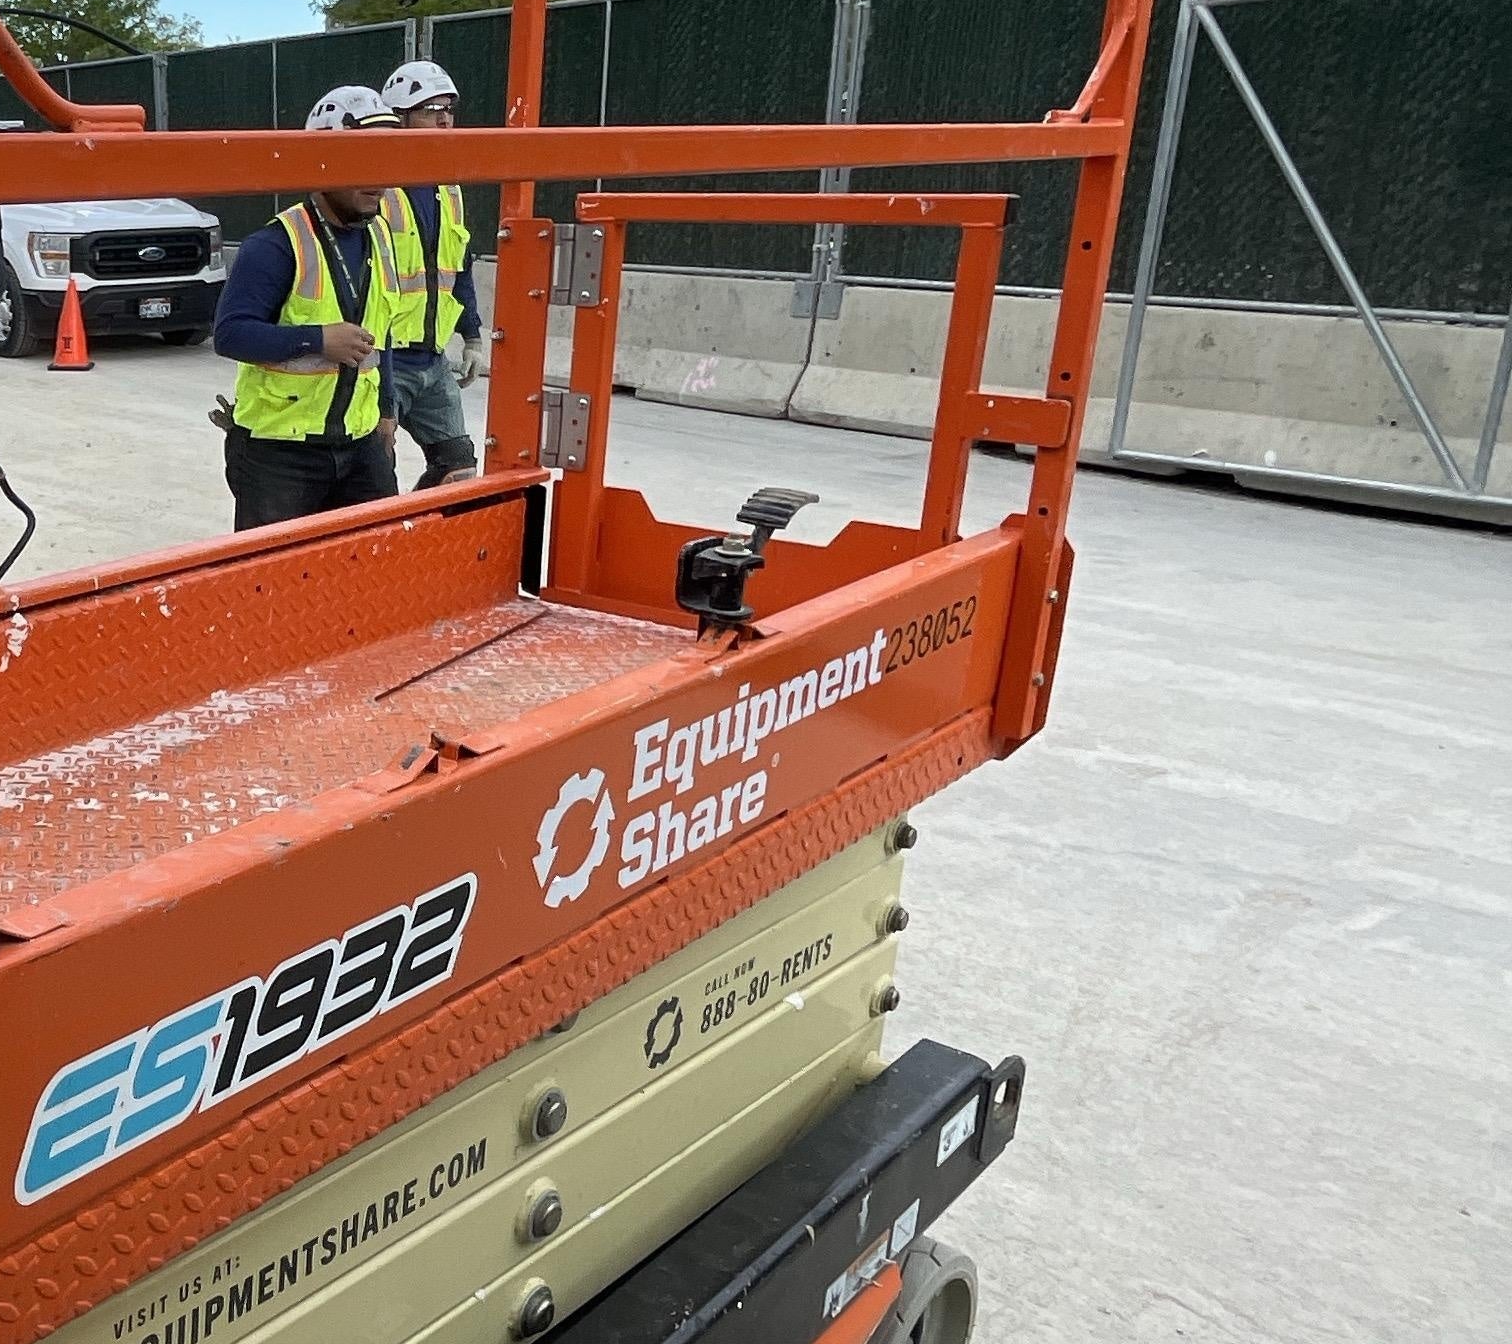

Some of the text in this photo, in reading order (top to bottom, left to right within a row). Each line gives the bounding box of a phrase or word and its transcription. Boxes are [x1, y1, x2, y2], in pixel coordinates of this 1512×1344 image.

[886, 595, 977, 673] 238052
[627, 627, 888, 803] Equipment
[617, 769, 768, 889] Share
[700, 933, 833, 1034] 888-80-RENTS
[704, 956, 756, 997] CALL NOW
[17, 874, 476, 1202] ES1932
[113, 1255, 241, 1341] VISIT US AT:
